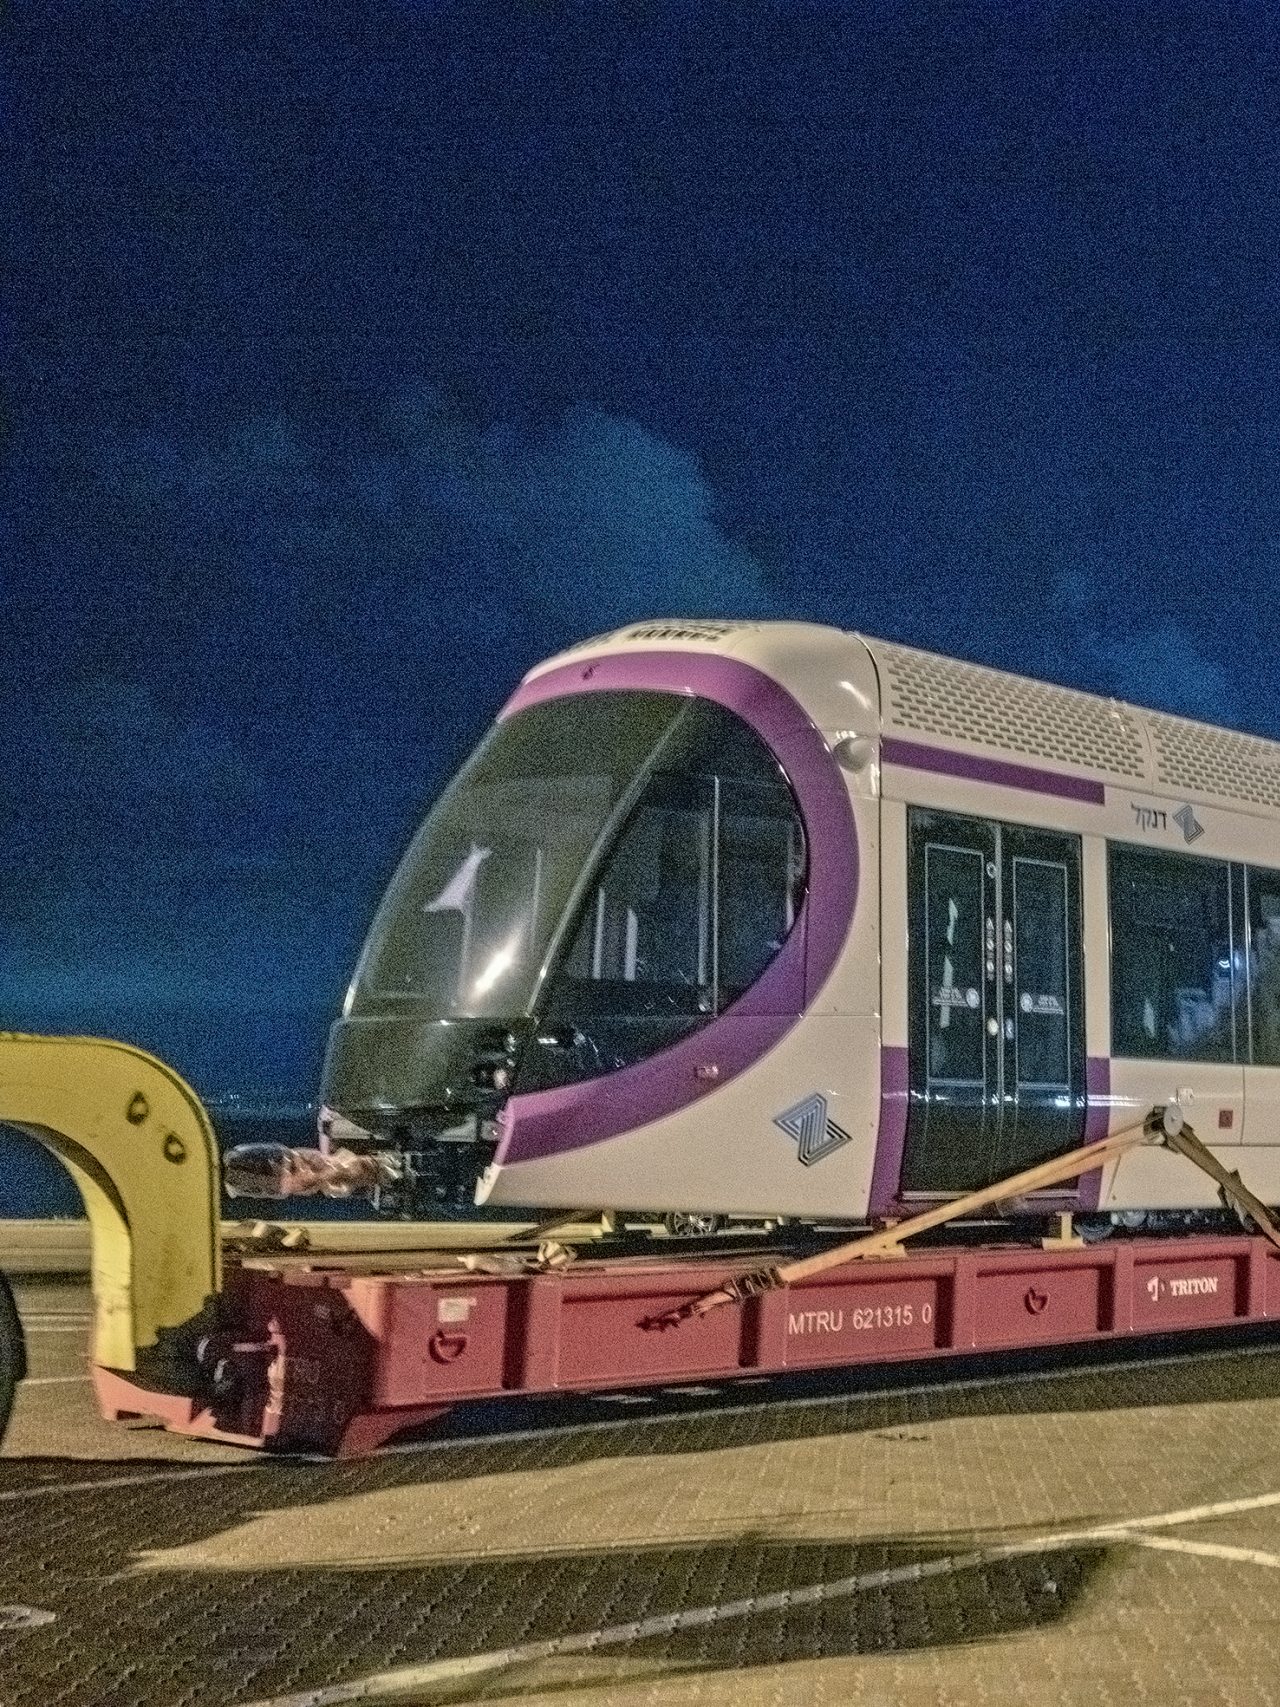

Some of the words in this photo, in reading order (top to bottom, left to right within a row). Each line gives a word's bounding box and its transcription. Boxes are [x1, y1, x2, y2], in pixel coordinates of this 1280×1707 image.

[1130, 801, 1167, 832] דנקל
[1170, 1277, 1218, 1296] TRITON
[788, 1309, 843, 1335] MTRU
[853, 1304, 913, 1330] 621315
[921, 1302, 932, 1324] 0
